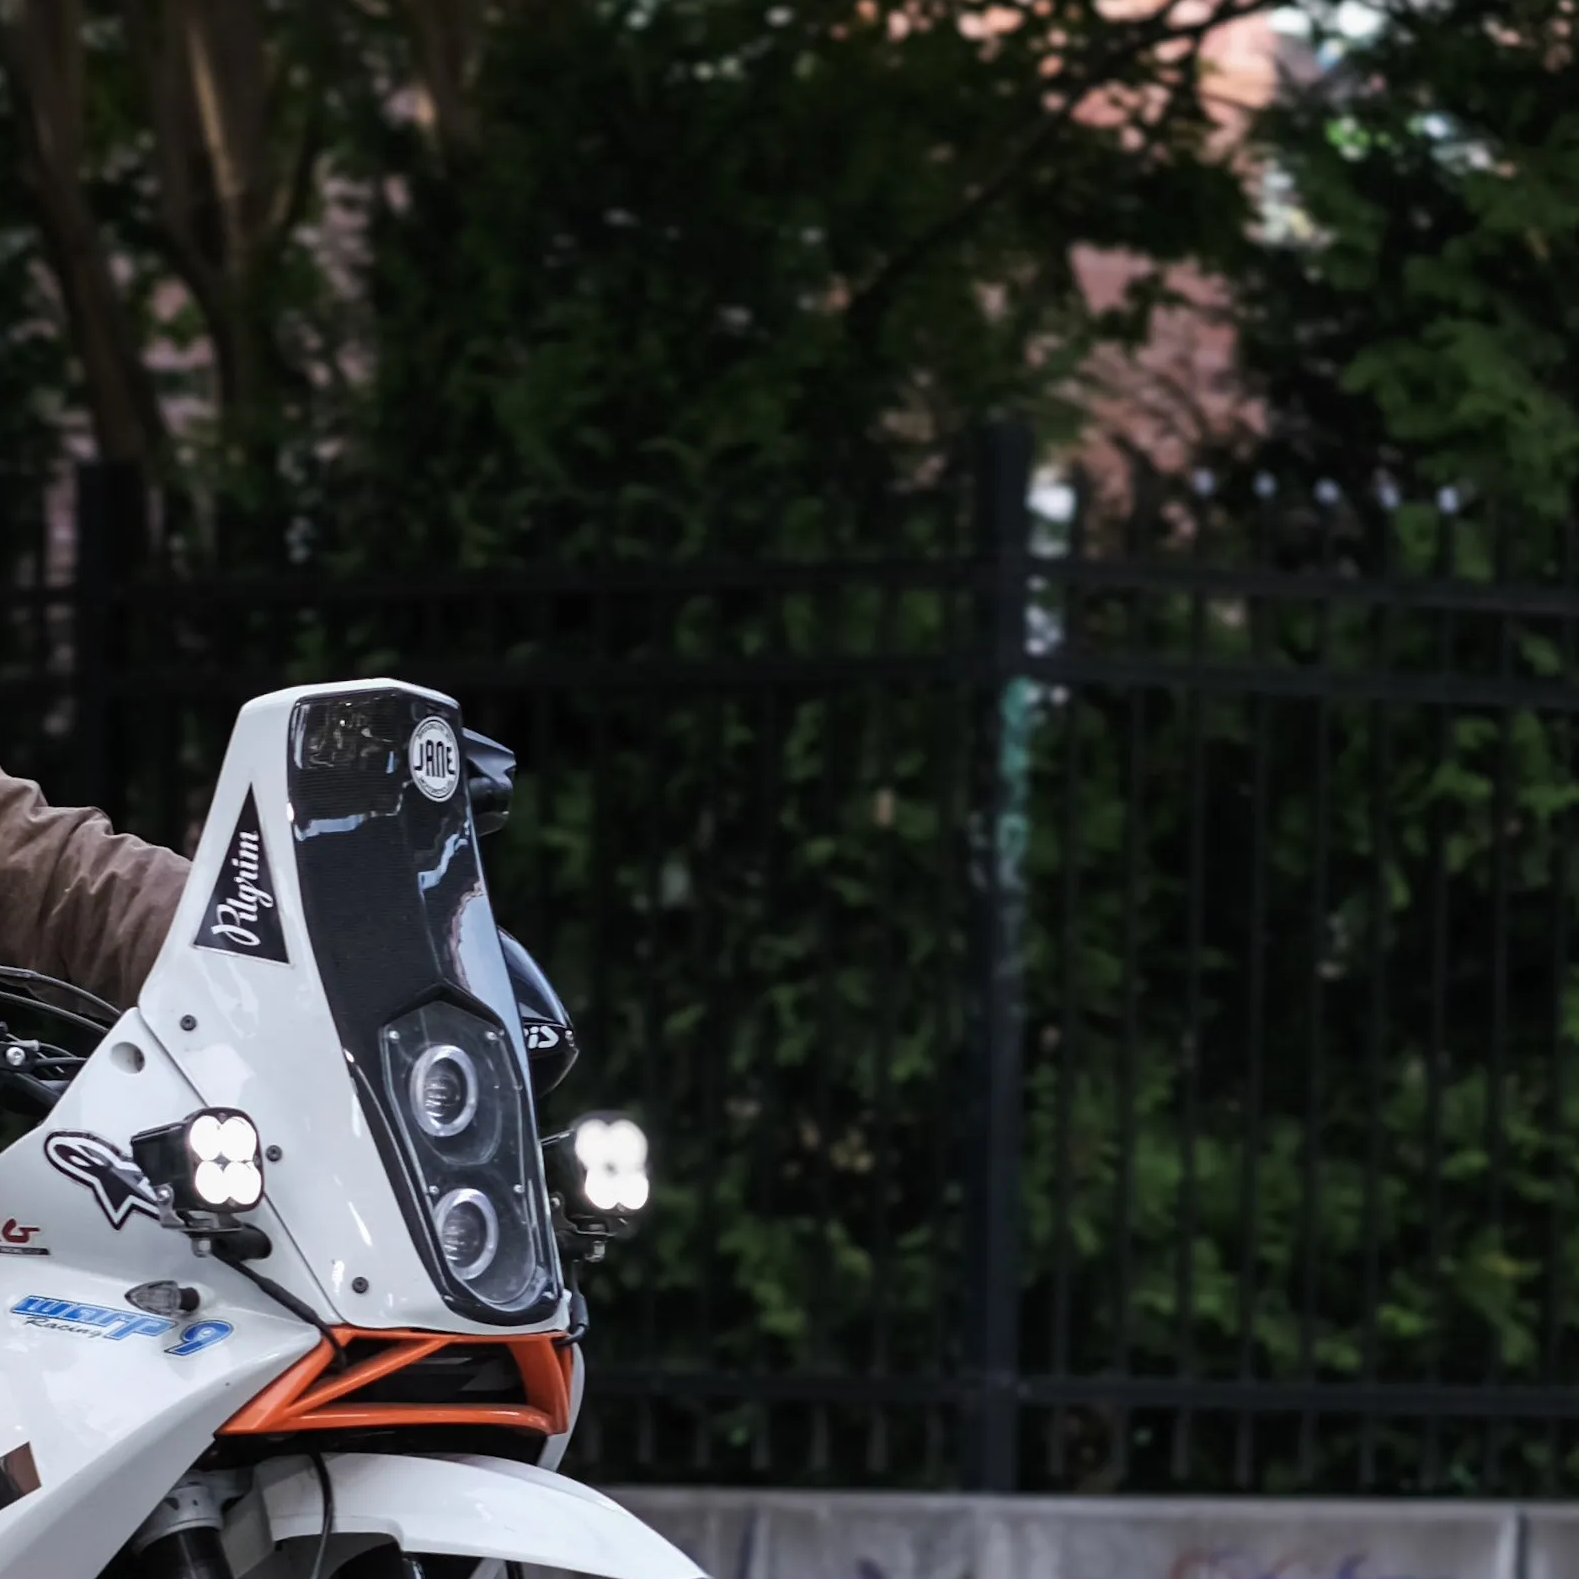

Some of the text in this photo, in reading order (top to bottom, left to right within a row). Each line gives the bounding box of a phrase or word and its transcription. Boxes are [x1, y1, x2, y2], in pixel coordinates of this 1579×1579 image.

[414, 739, 456, 779] JANE
[210, 830, 274, 947] Pilgrim
[164, 1320, 234, 1356] 9
